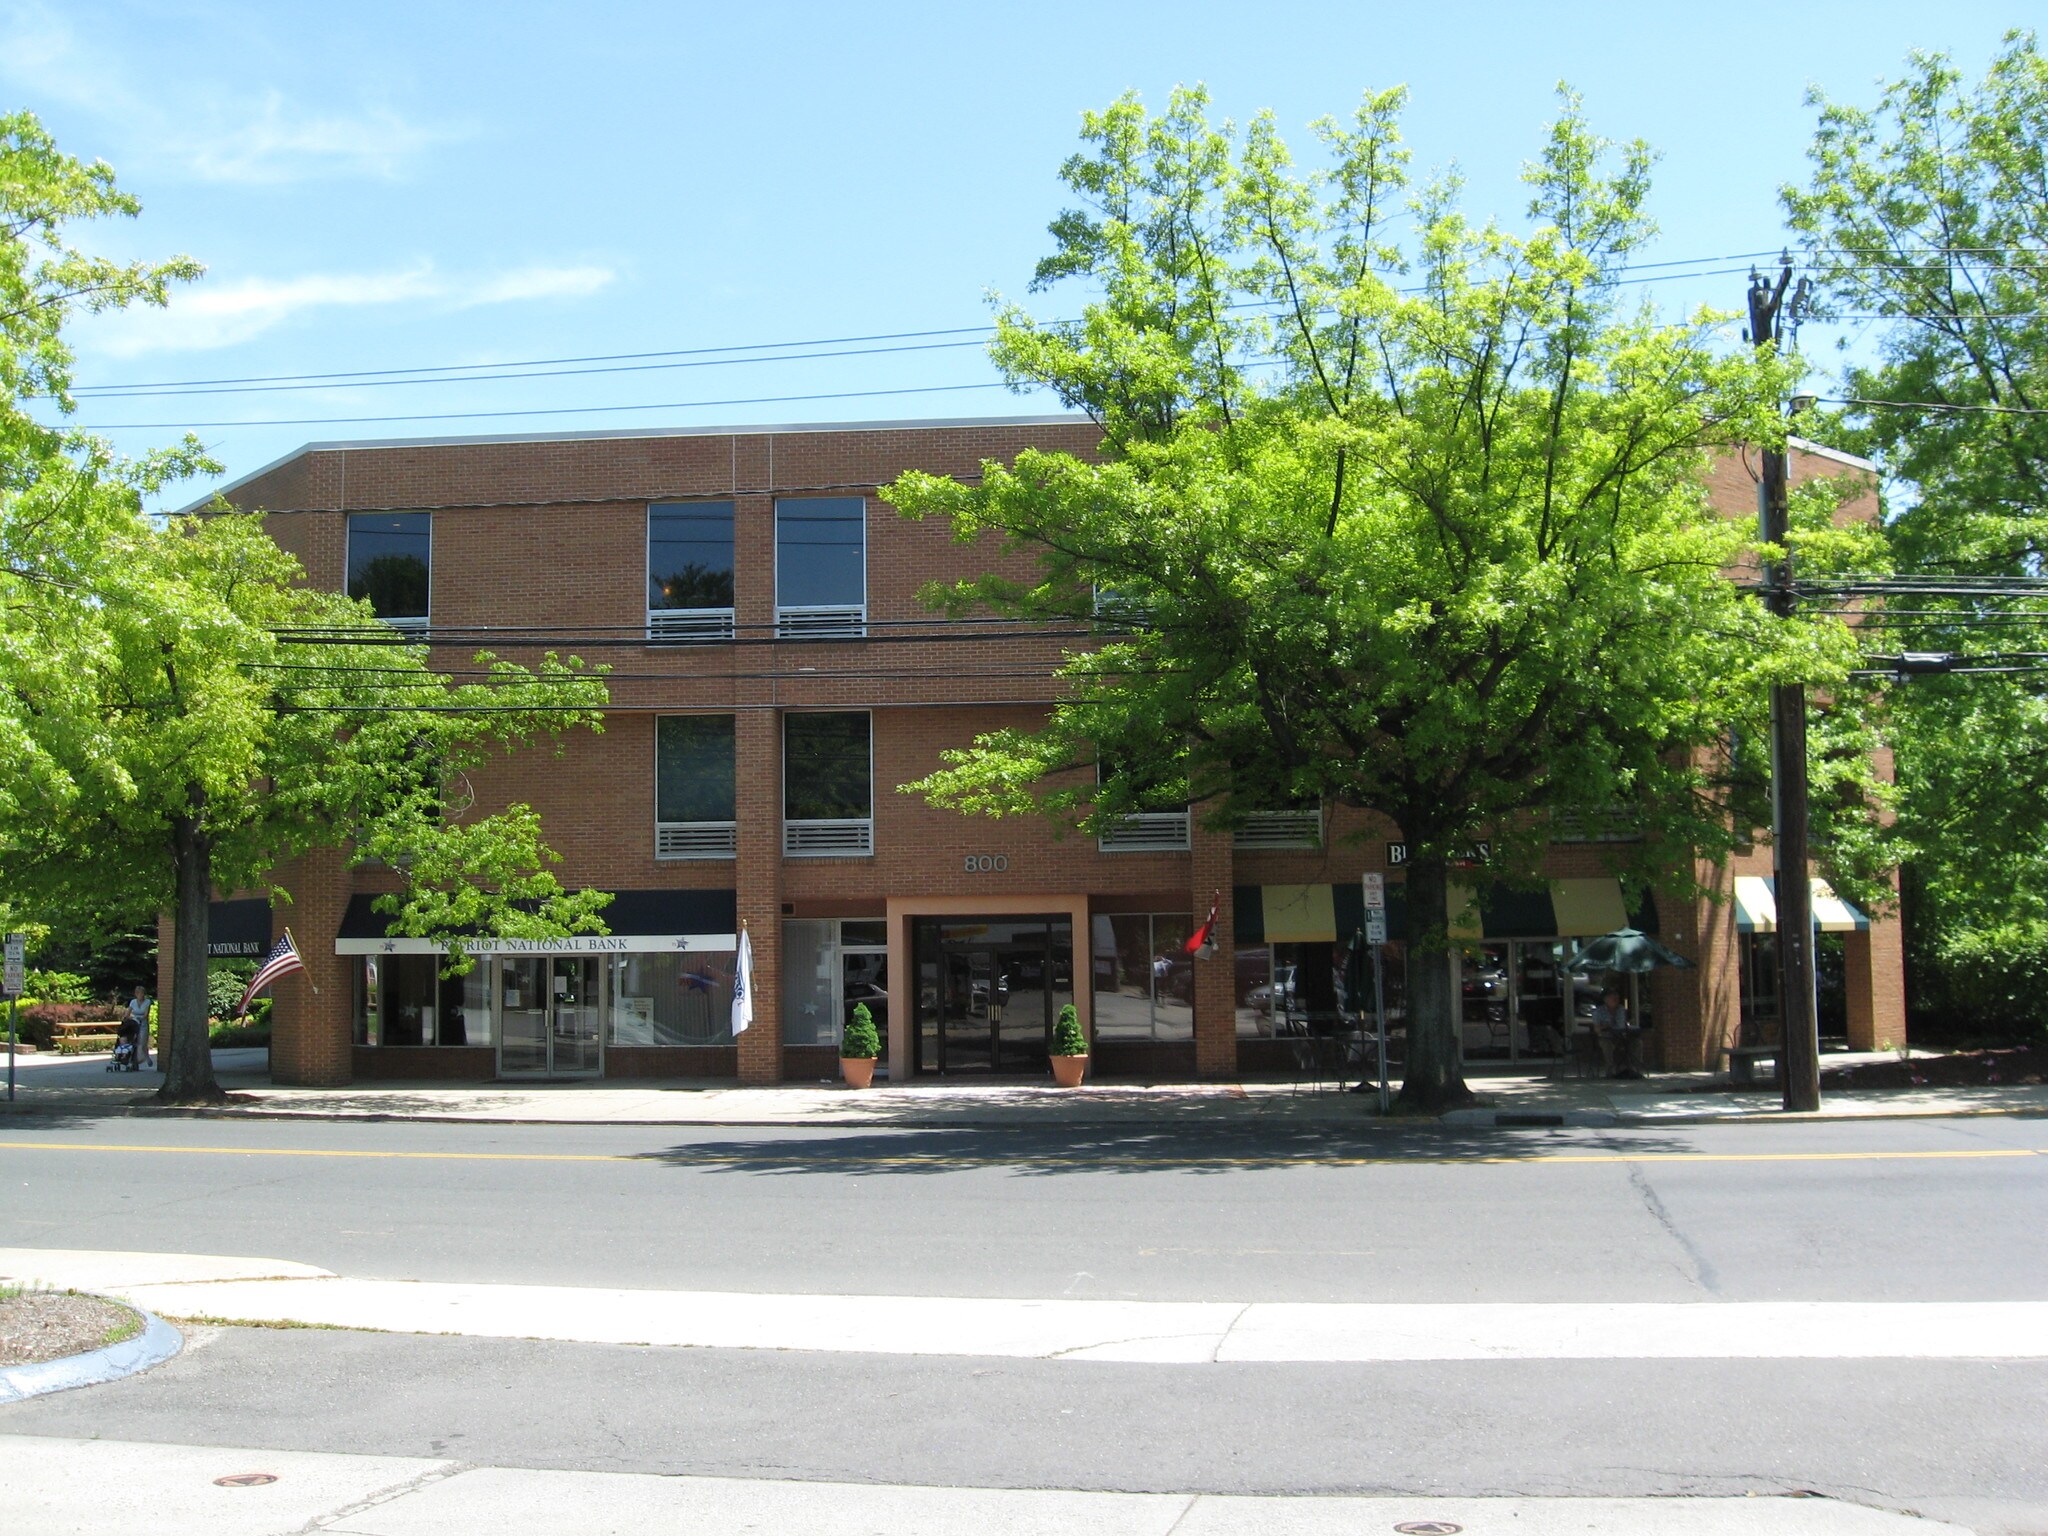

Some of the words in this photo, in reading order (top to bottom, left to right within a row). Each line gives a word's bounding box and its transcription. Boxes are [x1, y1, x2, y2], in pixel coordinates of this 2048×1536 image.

[964, 855, 1008, 872] 800
[213, 942, 241, 954] NATIONAL
[243, 941, 260, 953] BANK
[441, 940, 499, 951] PRIOT
[506, 939, 582, 951] NATIONAL
[588, 938, 628, 950] BANK
